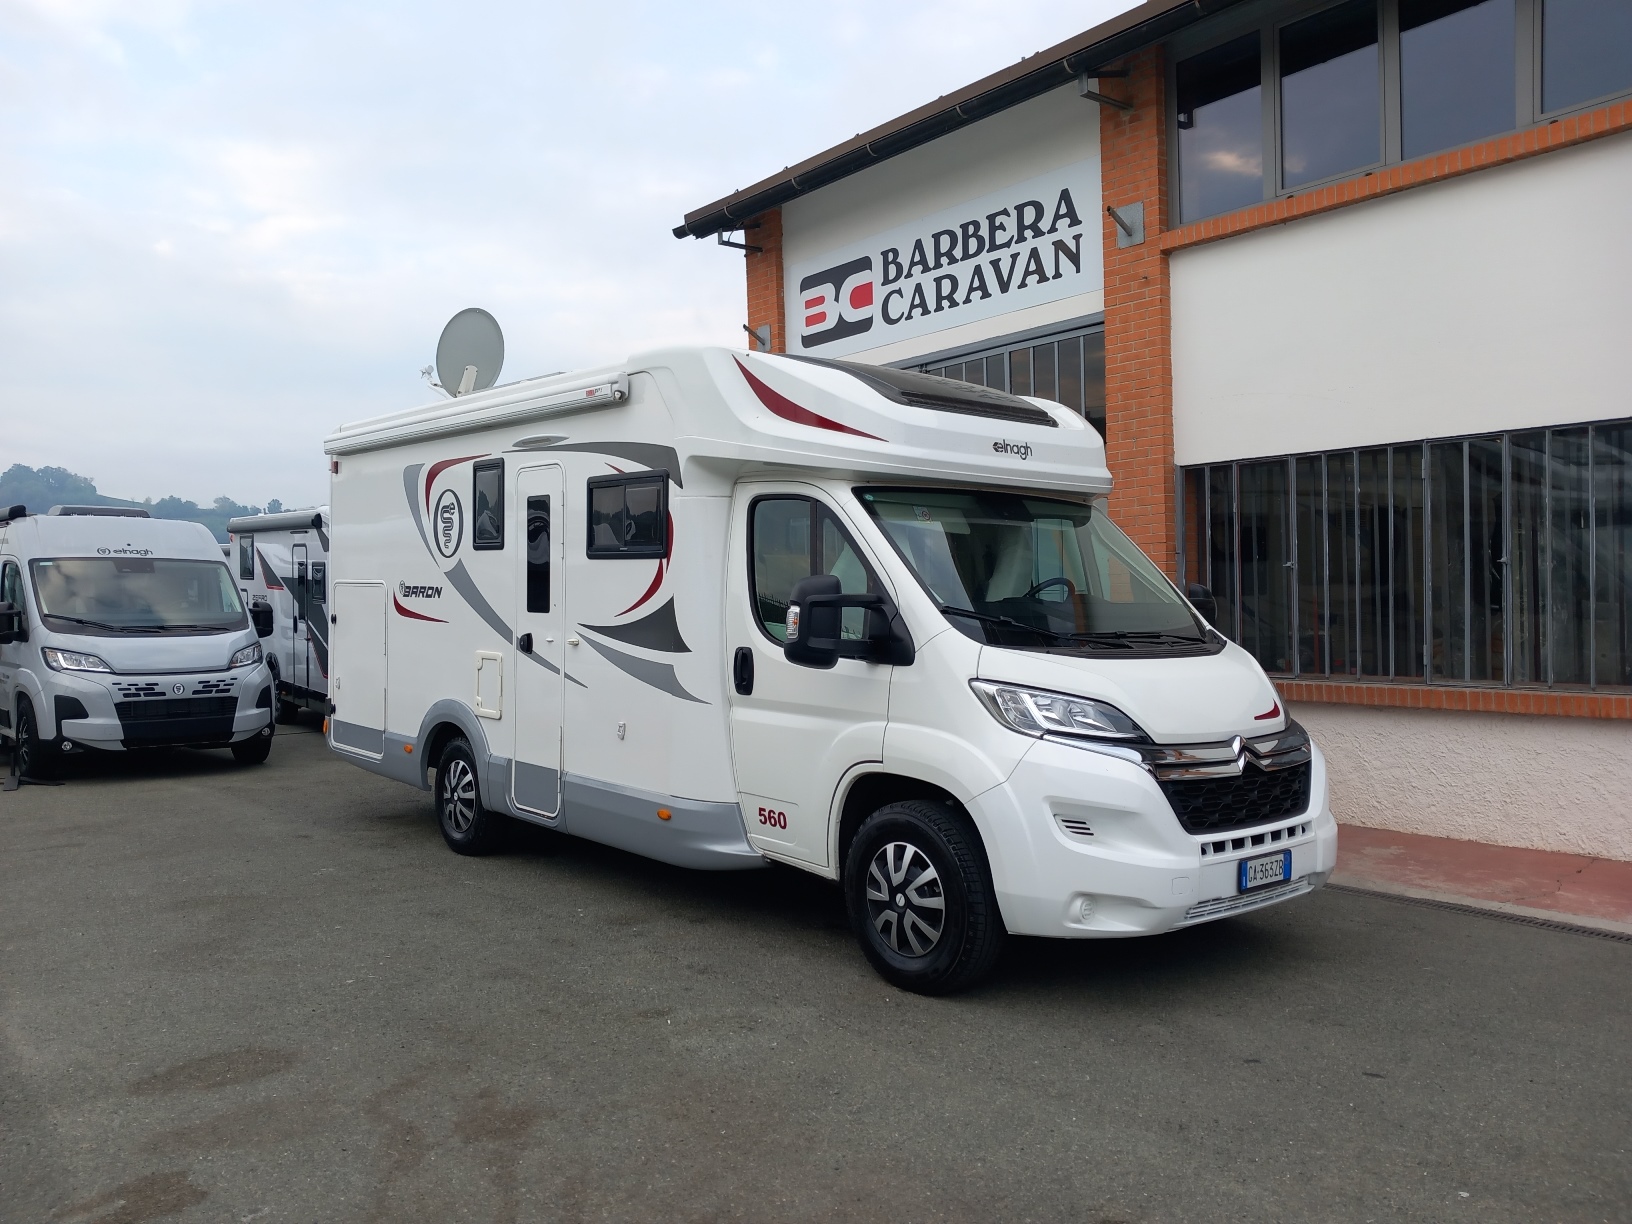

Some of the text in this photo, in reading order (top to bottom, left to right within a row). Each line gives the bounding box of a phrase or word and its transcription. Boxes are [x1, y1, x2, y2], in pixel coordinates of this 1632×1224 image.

[880, 187, 1083, 287] BARBERA
[880, 233, 1083, 326] CARAVAN
[992, 438, 1033, 461] elnagh
[112, 547, 154, 557] elnagh
[402, 585, 443, 599] BARON
[758, 806, 787, 830] 560
